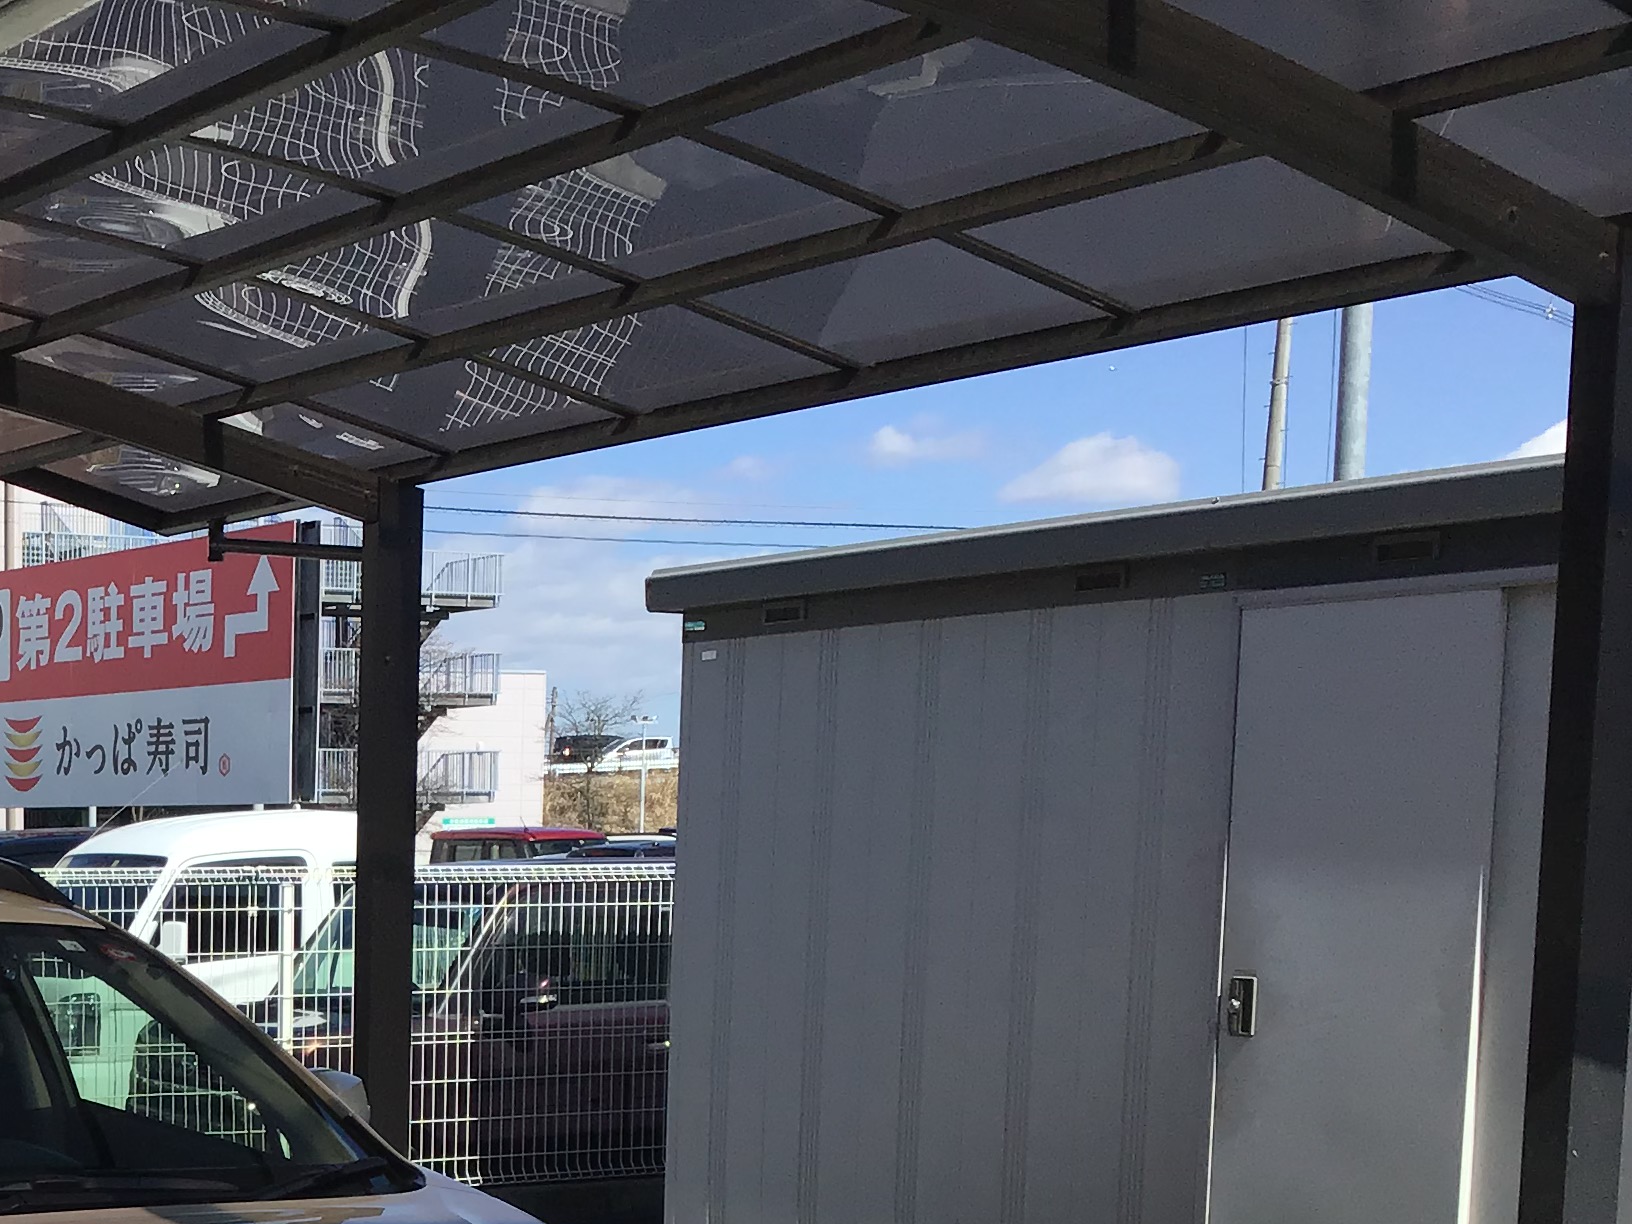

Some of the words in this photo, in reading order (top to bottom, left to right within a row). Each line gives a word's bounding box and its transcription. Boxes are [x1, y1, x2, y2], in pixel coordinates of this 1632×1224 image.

[15, 568, 215, 671] 第2駐車場
[55, 716, 211, 777] かっぱ寿司
